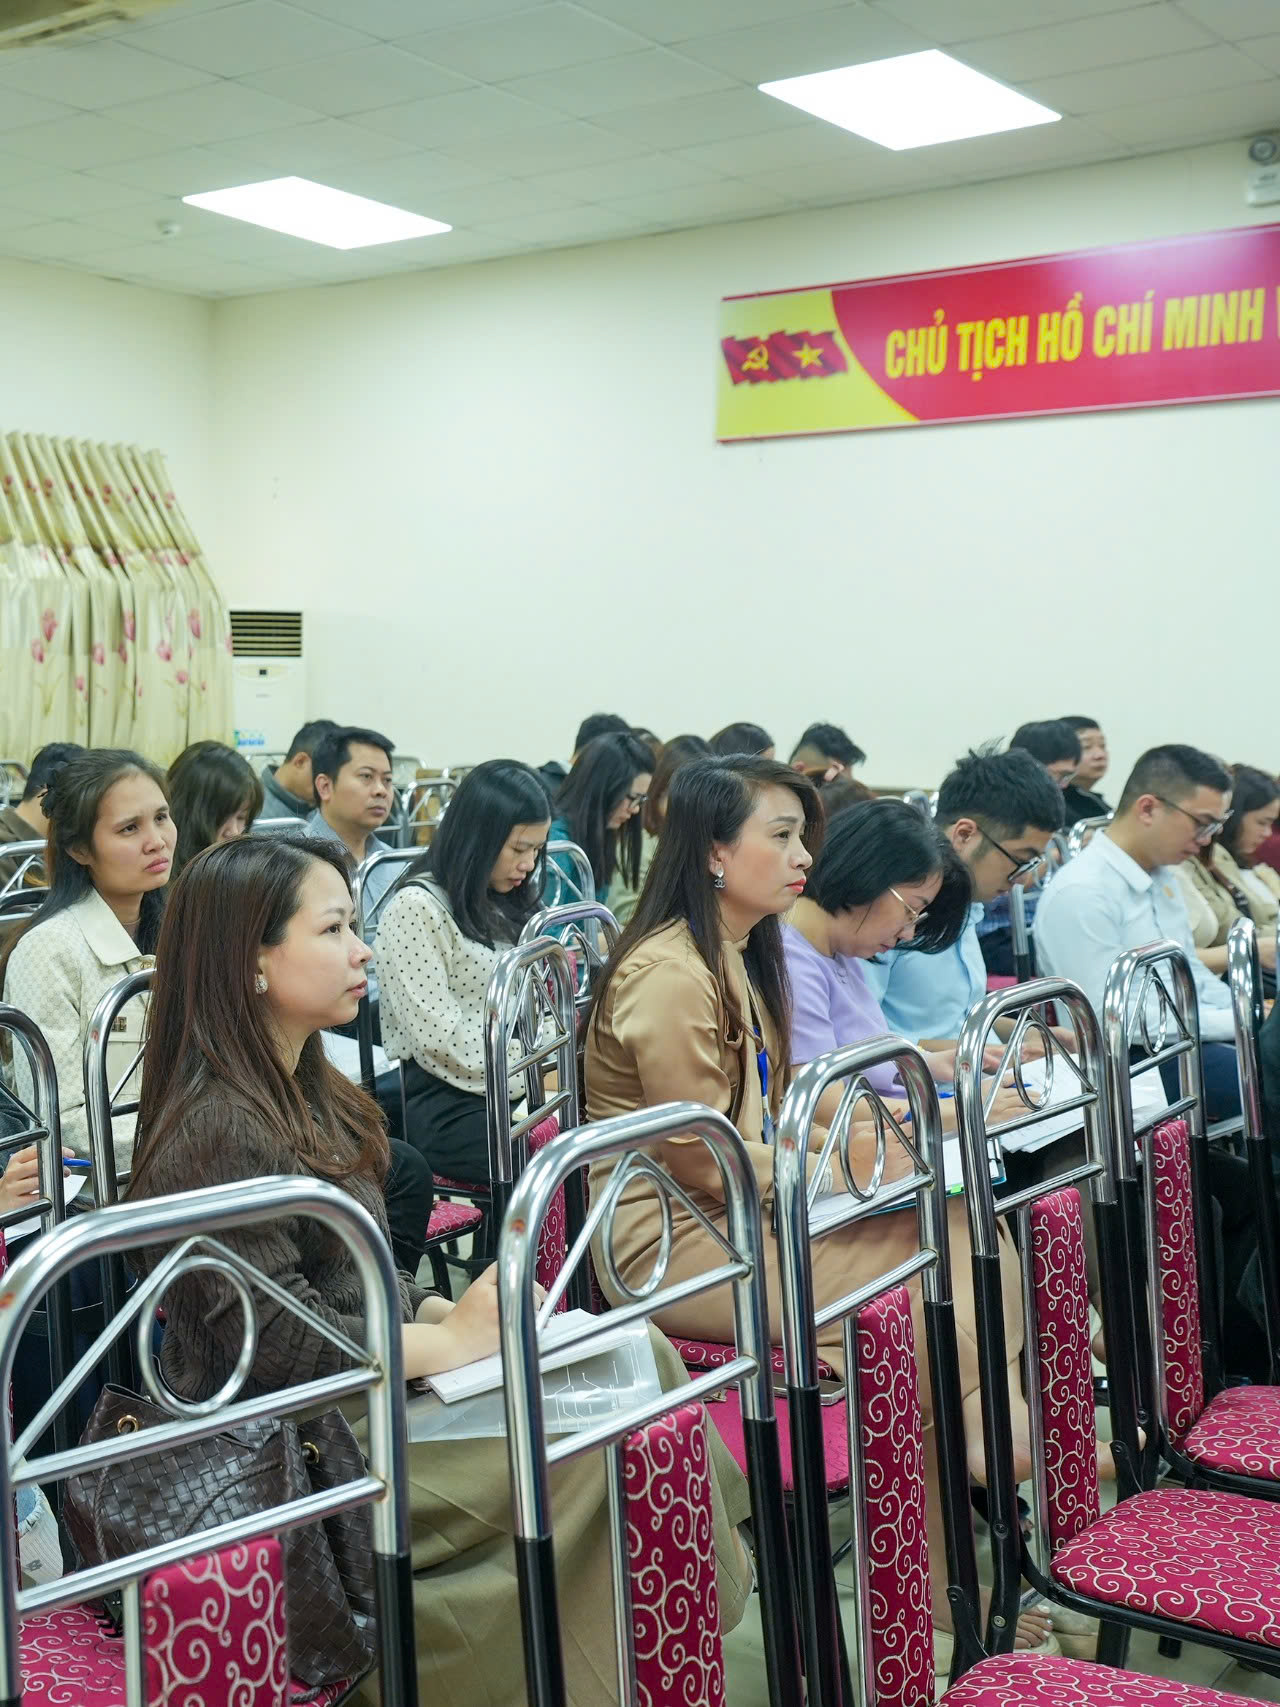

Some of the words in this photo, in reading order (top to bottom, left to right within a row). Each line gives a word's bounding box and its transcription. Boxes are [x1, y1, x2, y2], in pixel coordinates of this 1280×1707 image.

[885, 308, 949, 380] CHỦ
[956, 315, 1029, 381] TỊCH
[1036, 292, 1085, 364] HỒ
[1093, 290, 1153, 359] CHÍ
[1162, 287, 1266, 351] MINH
